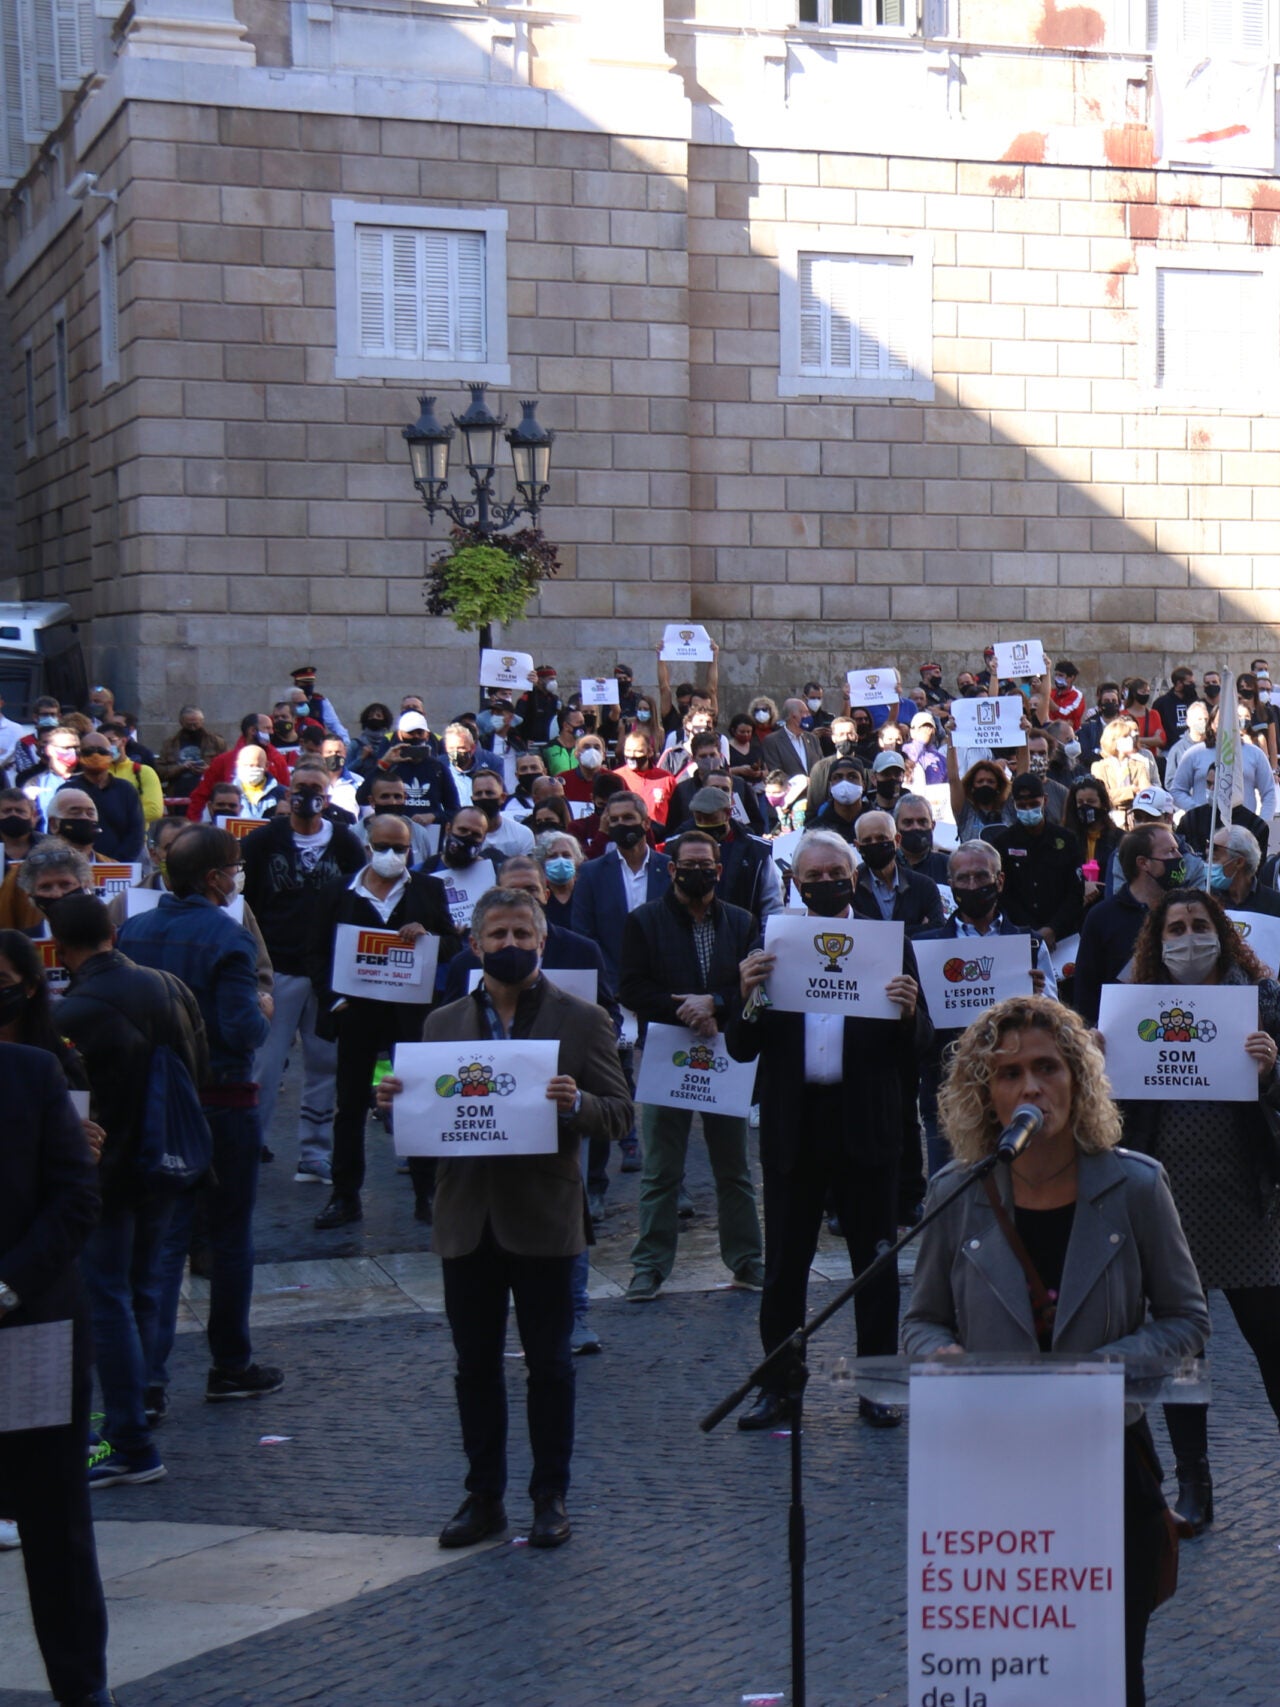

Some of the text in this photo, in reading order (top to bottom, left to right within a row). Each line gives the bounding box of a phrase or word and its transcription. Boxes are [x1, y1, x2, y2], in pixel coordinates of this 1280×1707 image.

[358, 968, 381, 977] ESPORT
[808, 978, 858, 991] VOLEM
[806, 989, 860, 1001] COMPETIR
[944, 986, 995, 998] L'ESPORT
[945, 998, 996, 1009] ÉS SEGUR
[1159, 1050, 1196, 1063] SOM
[1156, 1064, 1198, 1074] SERVEI
[684, 1074, 710, 1085] SOM
[1144, 1076, 1210, 1086] ESSENCIAL
[681, 1083, 711, 1094] SERVEI
[670, 1090, 717, 1103] ESSENCIAL
[457, 1105, 494, 1118] SOM
[454, 1119, 496, 1130] SERVEI
[442, 1131, 508, 1142] ESSENCIAL
[922, 1530, 1055, 1555] L'ESPORT
[922, 1562, 1112, 1592] ÉS UN SERVEI
[922, 1604, 1076, 1630] ESSENCIAL
[921, 1652, 1050, 1682] Som part
[922, 1686, 987, 1707] de la
